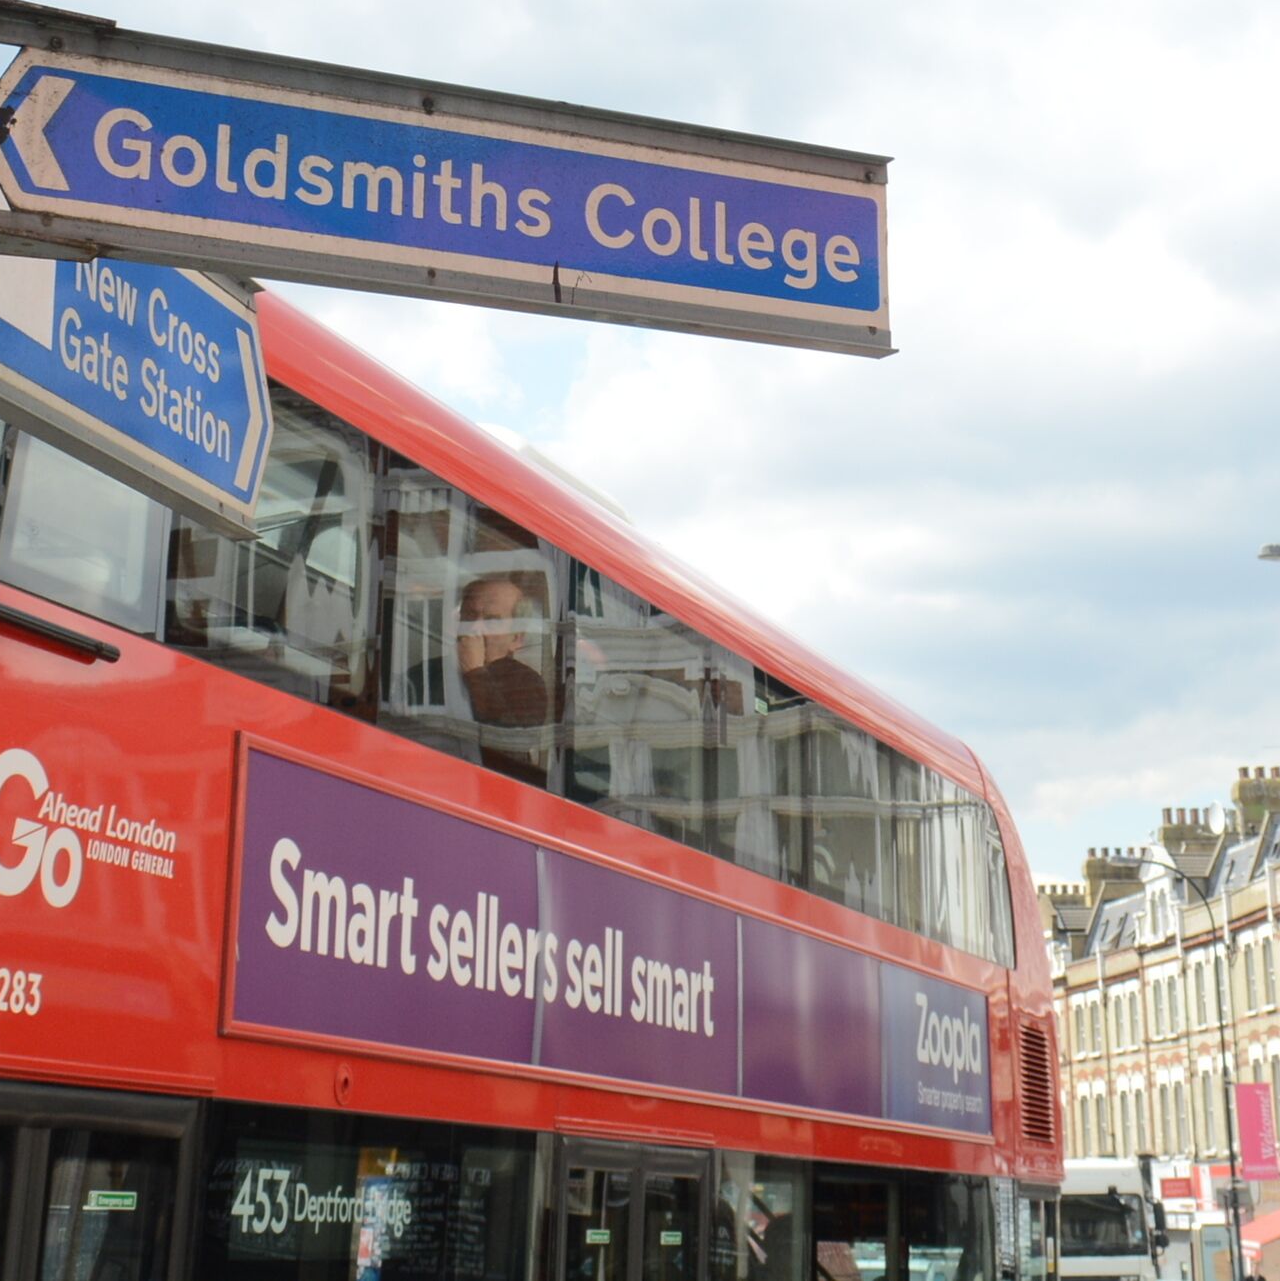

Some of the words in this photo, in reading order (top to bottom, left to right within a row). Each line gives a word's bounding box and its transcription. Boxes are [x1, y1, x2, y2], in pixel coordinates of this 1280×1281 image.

[93, 105, 552, 239] Goldsmiths
[584, 181, 860, 289] College
[75, 258, 138, 327] New
[147, 287, 220, 384] Cross
[59, 307, 129, 401] Gate
[139, 357, 231, 463] Station
[37, 790, 104, 833] Ahead
[105, 804, 177, 853] London
[86, 838, 130, 868] LONDON
[131, 851, 174, 879] GENERAL
[264, 836, 418, 977] Smart
[425, 891, 558, 1005] sellers
[564, 926, 623, 1018] sell
[630, 953, 715, 1038] smart
[915, 991, 983, 1085] Zoopla
[1255, 1088, 1275, 1160] Welcome!
[230, 1168, 291, 1235] 453
[293, 1182, 364, 1234] Deptford
